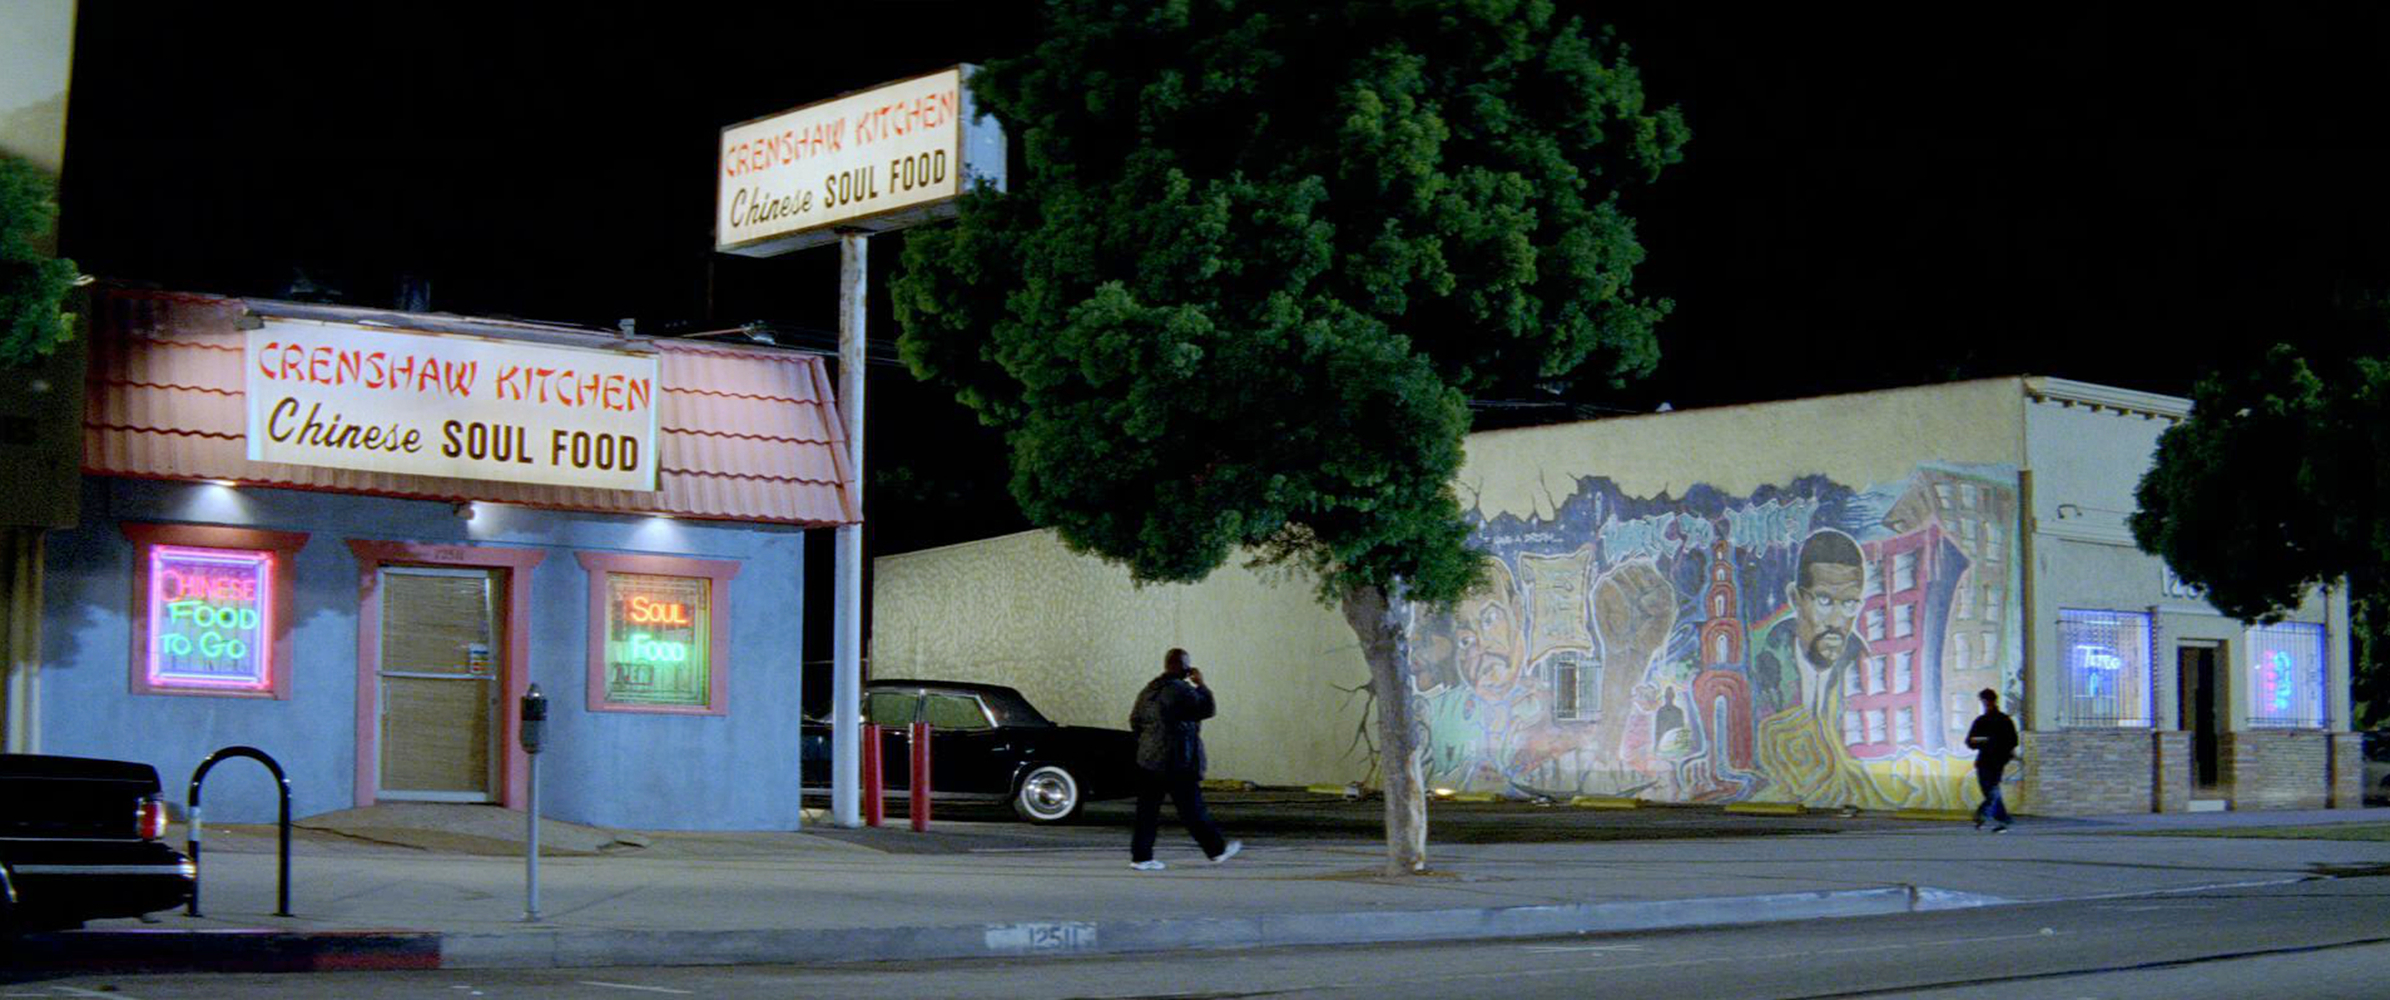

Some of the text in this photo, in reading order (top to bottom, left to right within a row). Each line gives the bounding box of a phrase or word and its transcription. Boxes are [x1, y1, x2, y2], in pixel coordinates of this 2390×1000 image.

[725, 90, 957, 177] CRENSHAW KITCHEN
[730, 149, 946, 228] Chinese SOUL FOOD
[258, 341, 652, 412] CRENSHAW KITCHEN
[267, 396, 639, 472] Chinese SOUL FOOD
[161, 568, 256, 601] CHINESE
[167, 600, 258, 630] FOOD
[1029, 926, 1077, 949] 12511
